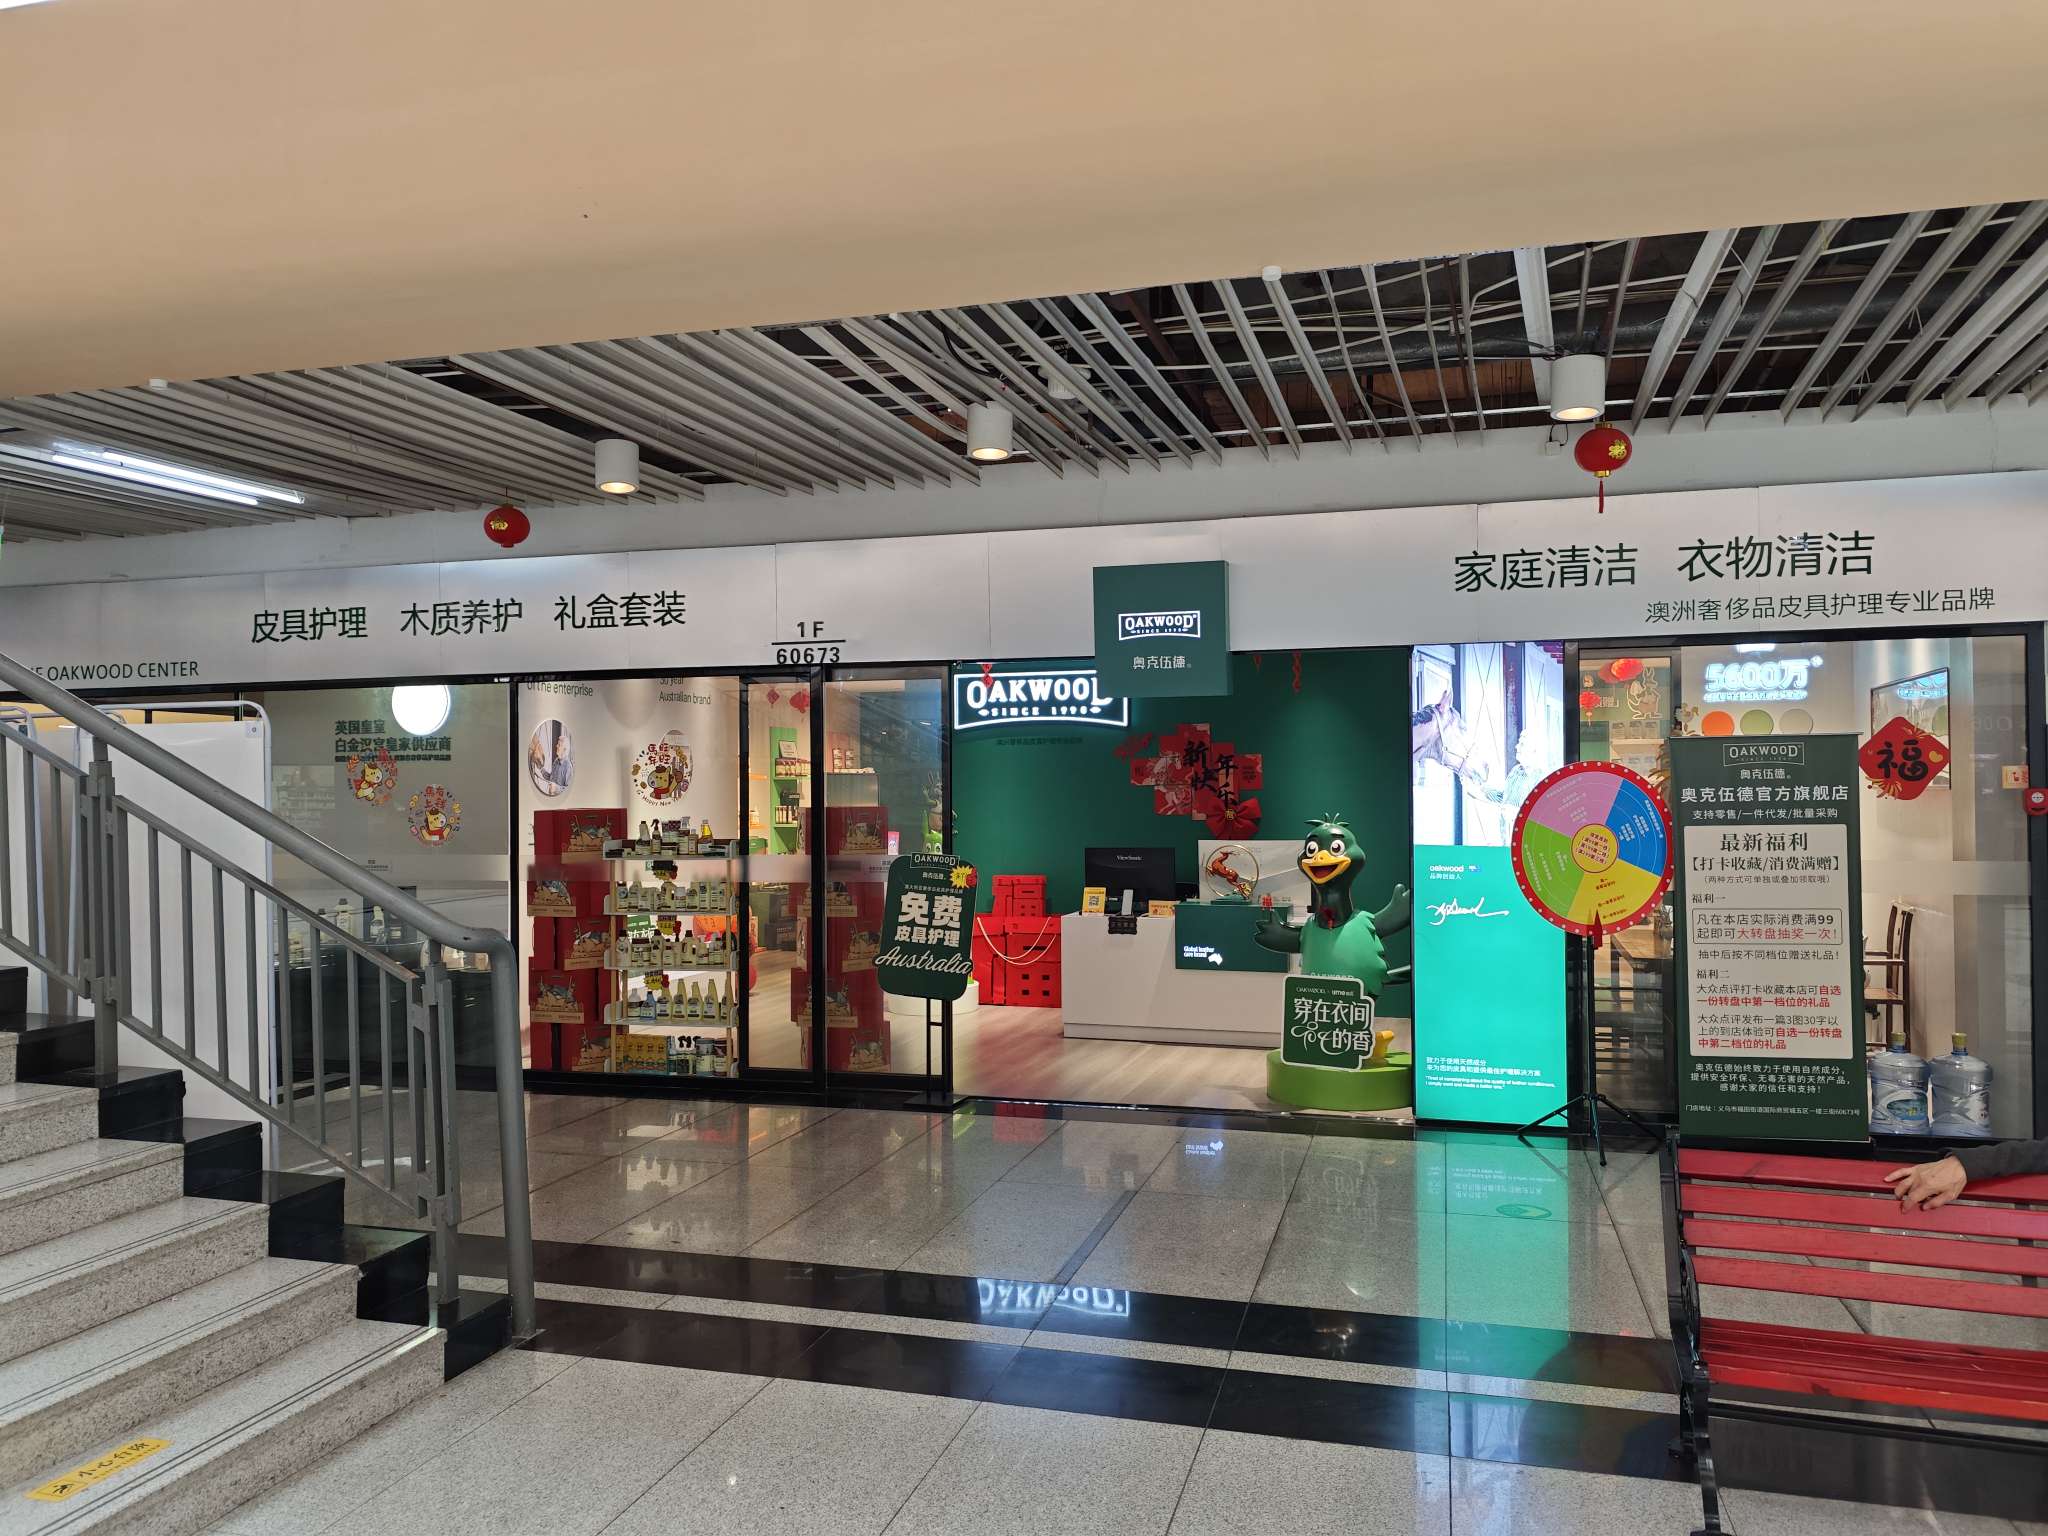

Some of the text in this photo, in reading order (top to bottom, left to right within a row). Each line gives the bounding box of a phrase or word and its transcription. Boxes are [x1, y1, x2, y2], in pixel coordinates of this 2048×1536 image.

[1453, 531, 1875, 593] 家庭清洁 衣物清洁
[1645, 586, 1995, 623] 澳洲奢侈品皮具护理专业品牌
[252, 590, 686, 643] 皮具护理 木质养护 礼盒套装
[1125, 614, 1194, 631] OAKWOOD
[776, 647, 840, 664] 60673
[1132, 656, 1186, 669] 奥克伍德
[47, 663, 133, 681] OAKWOOD
[137, 661, 199, 678] CENTER
[554, 683, 593, 698] enterprise
[693, 693, 711, 705] brand
[335, 719, 385, 735] 英国皇室
[1729, 745, 1799, 759] OAKWOOD
[1877, 740, 1929, 781] 福
[1740, 768, 1786, 780] 奥克伍德
[1680, 785, 1849, 803] 奥克伍德官方旗舰店
[1692, 808, 1838, 820] 支持零售/一件代发/批量采购
[1720, 832, 1808, 852] 最新福利
[914, 854, 956, 866] OAKWOOD
[1693, 856, 1840, 872] 【打卡收藏/消费满赠】
[1692, 893, 1726, 904] 福利一
[898, 891, 963, 929] 免费
[1696, 914, 1834, 925] 凡在本店实际消费满99
[895, 925, 961, 948] 皮具护理
[875, 946, 972, 975] Australia
[1696, 969, 1730, 980] 福利二
[1696, 984, 1841, 995] 大众点评打卡收藏本店可自选
[1697, 996, 1830, 1008] 一份转盘中第一档位的礼品
[1293, 997, 1370, 1029] 穿在衣间
[1698, 1014, 1839, 1026] 大众点评发布一篇3图30字以
[1332, 1028, 1371, 1051] 的香
[1698, 1027, 1842, 1038] 上的到店体验可自选一份转盘
[1698, 1039, 1786, 1049] 中第二档位的礼品
